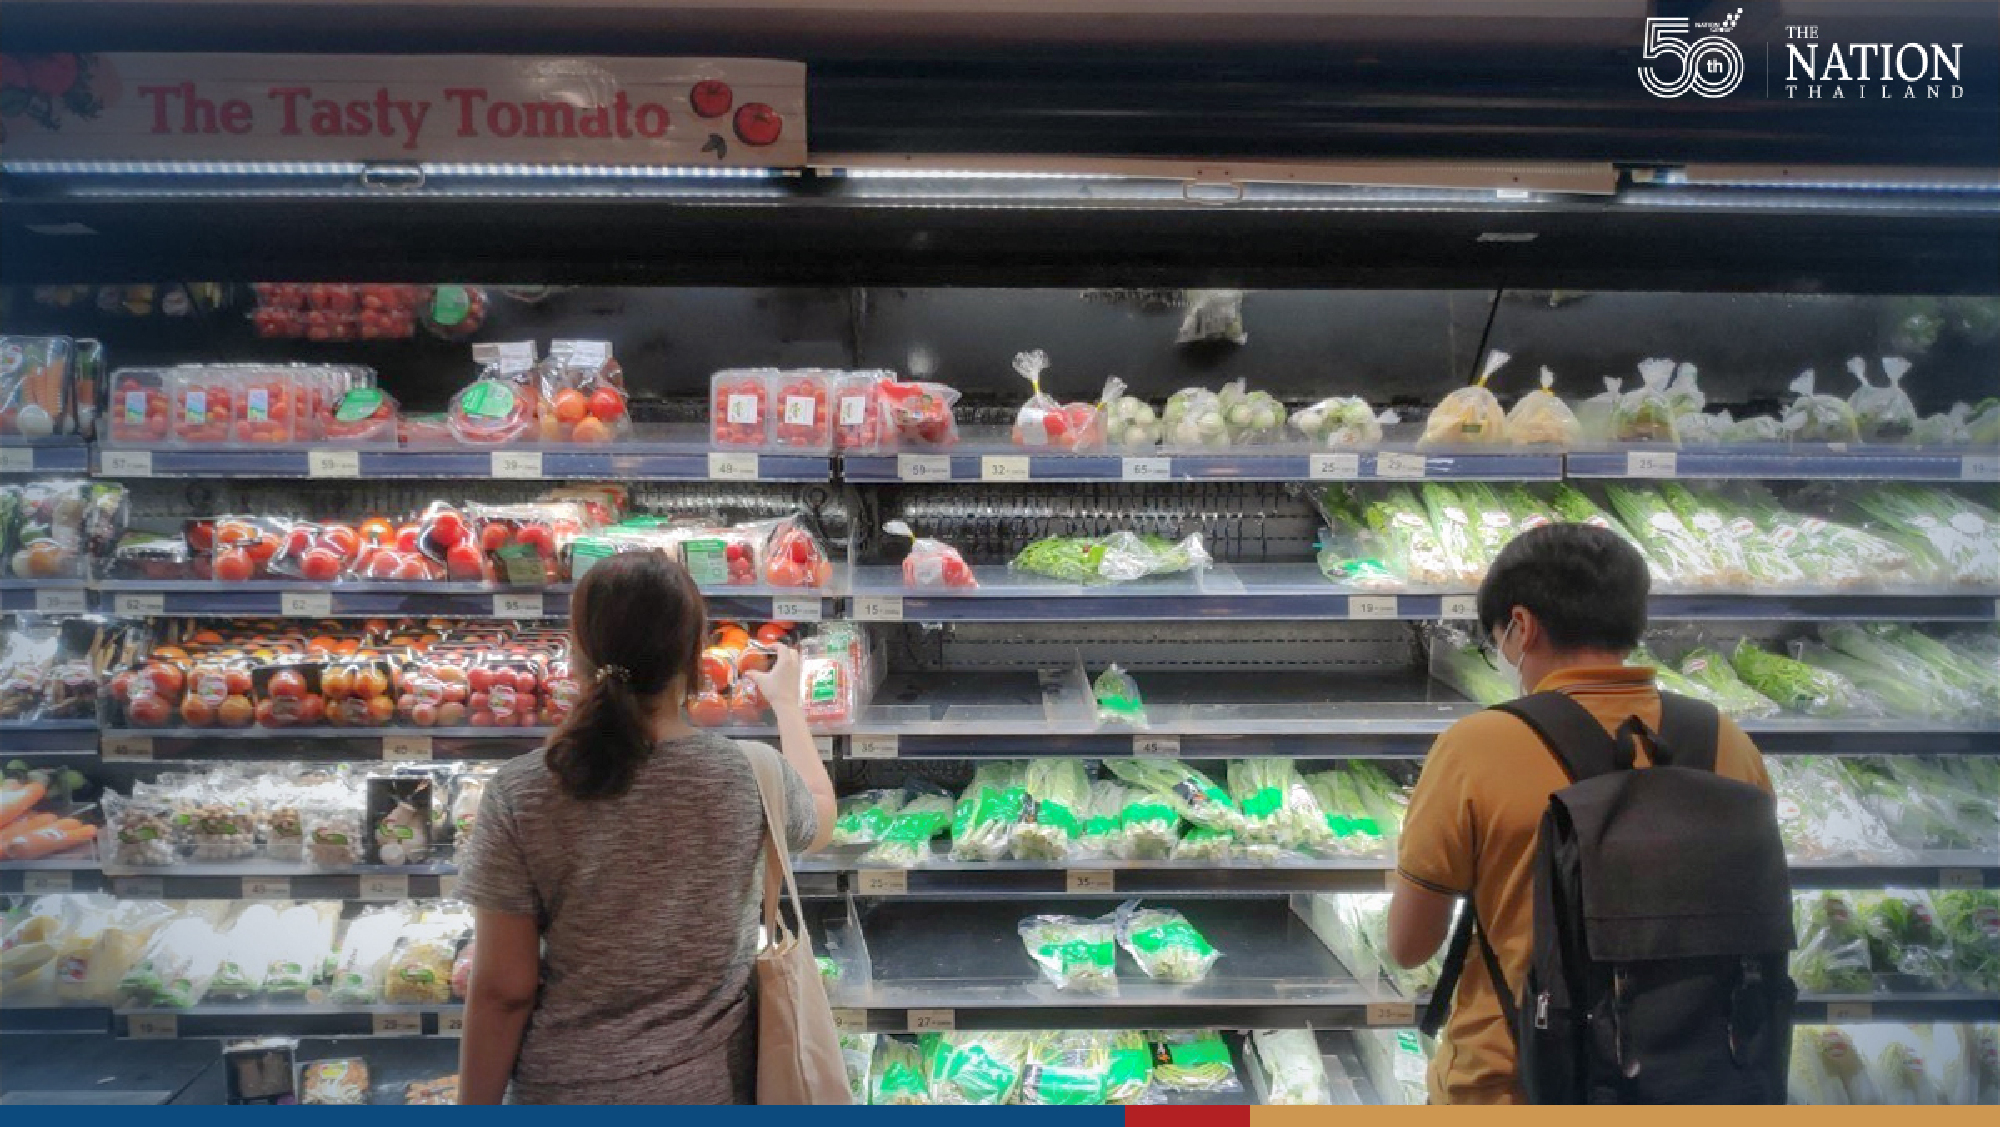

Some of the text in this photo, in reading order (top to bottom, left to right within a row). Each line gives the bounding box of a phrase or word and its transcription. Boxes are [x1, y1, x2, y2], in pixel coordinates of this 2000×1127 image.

[137, 81, 671, 150] The Tasty Tomato
